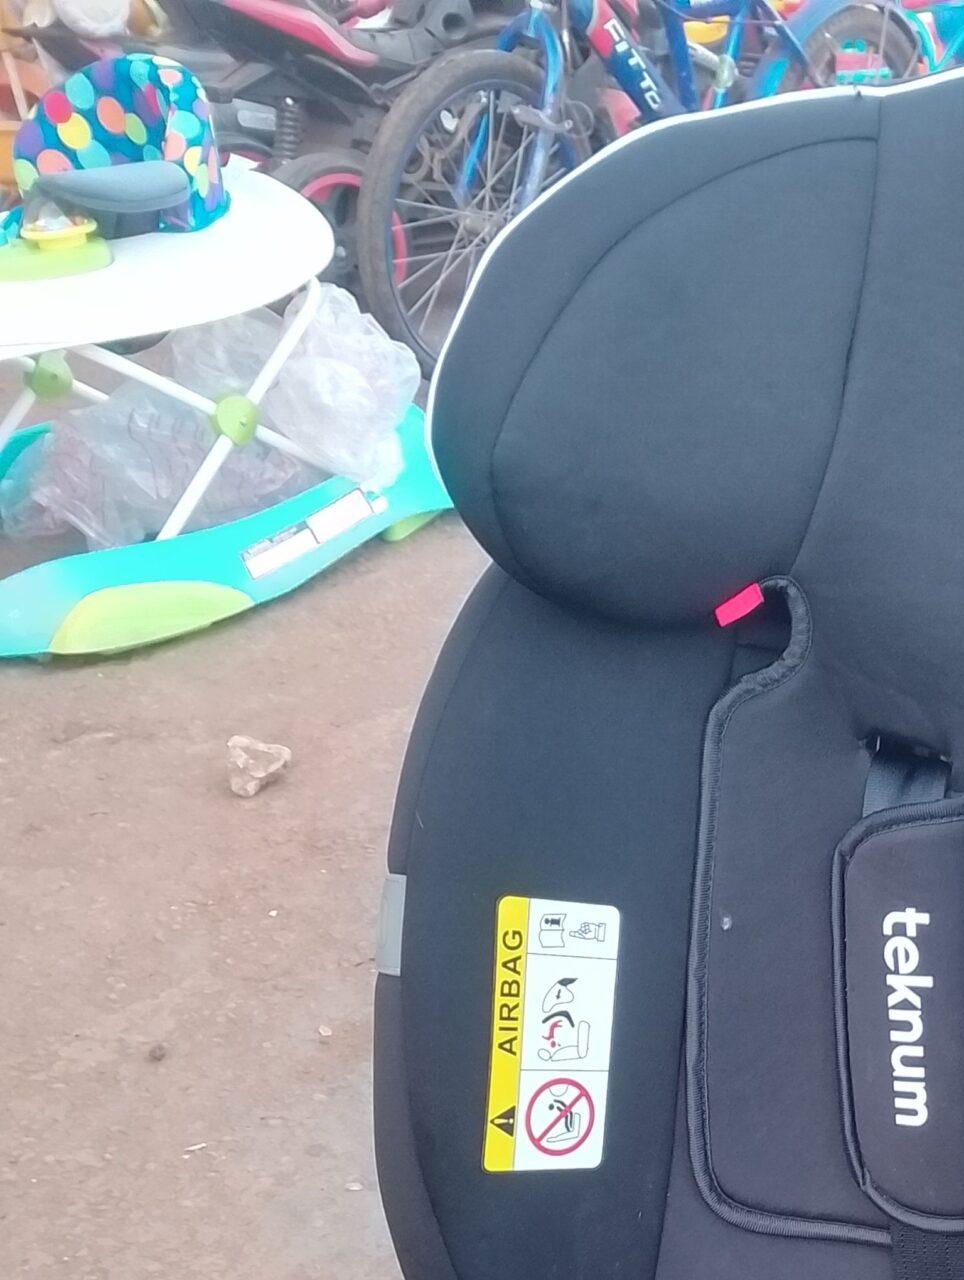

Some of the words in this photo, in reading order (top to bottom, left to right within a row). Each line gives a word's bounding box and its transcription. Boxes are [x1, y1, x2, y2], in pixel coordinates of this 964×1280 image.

[603, 17, 661, 110] FITTO
[498, 929, 523, 1057] AIRBAG
[882, 907, 934, 1127] teknum
